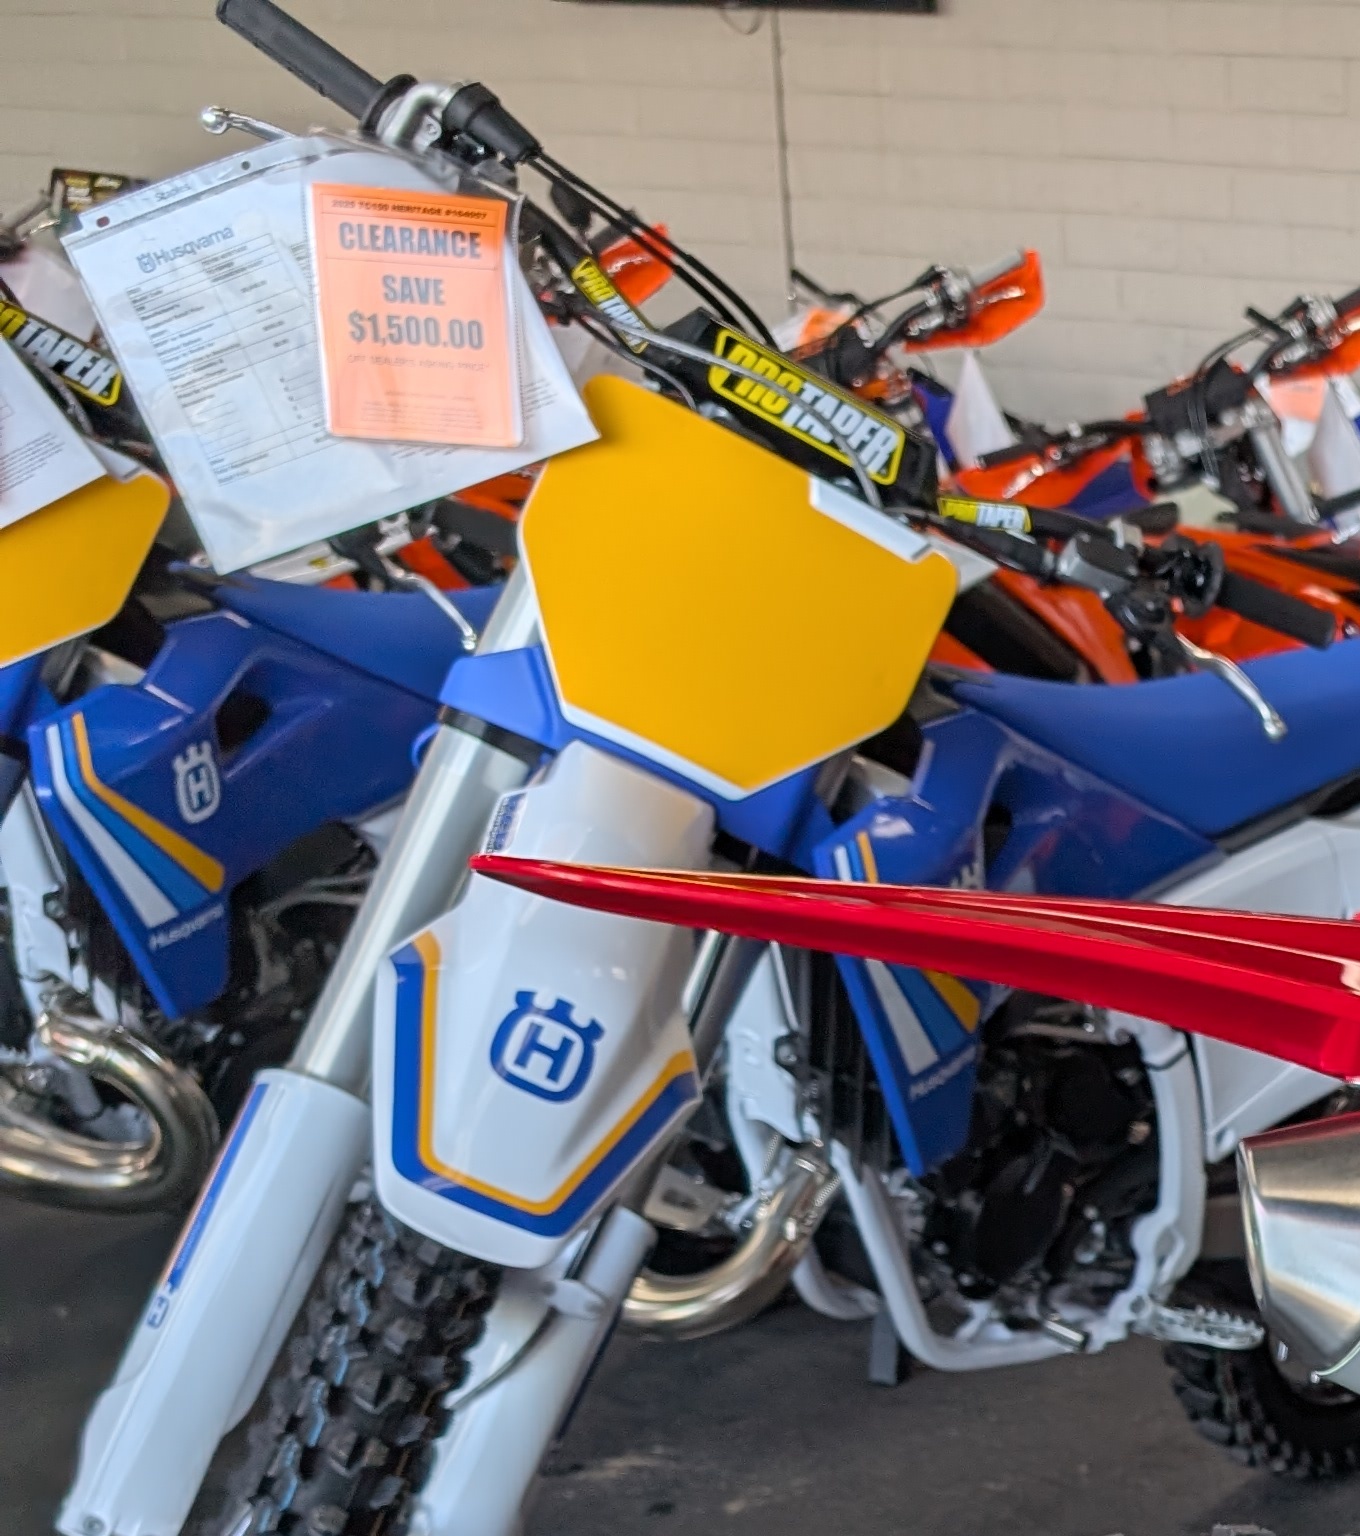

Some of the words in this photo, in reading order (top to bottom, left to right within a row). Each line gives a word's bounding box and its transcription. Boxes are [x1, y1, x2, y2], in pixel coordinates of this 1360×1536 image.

[152, 226, 234, 266] Husqvarna
[338, 221, 483, 259] CLEARANCE
[381, 274, 446, 306] SAVE
[347, 309, 485, 350] $1,500.00
